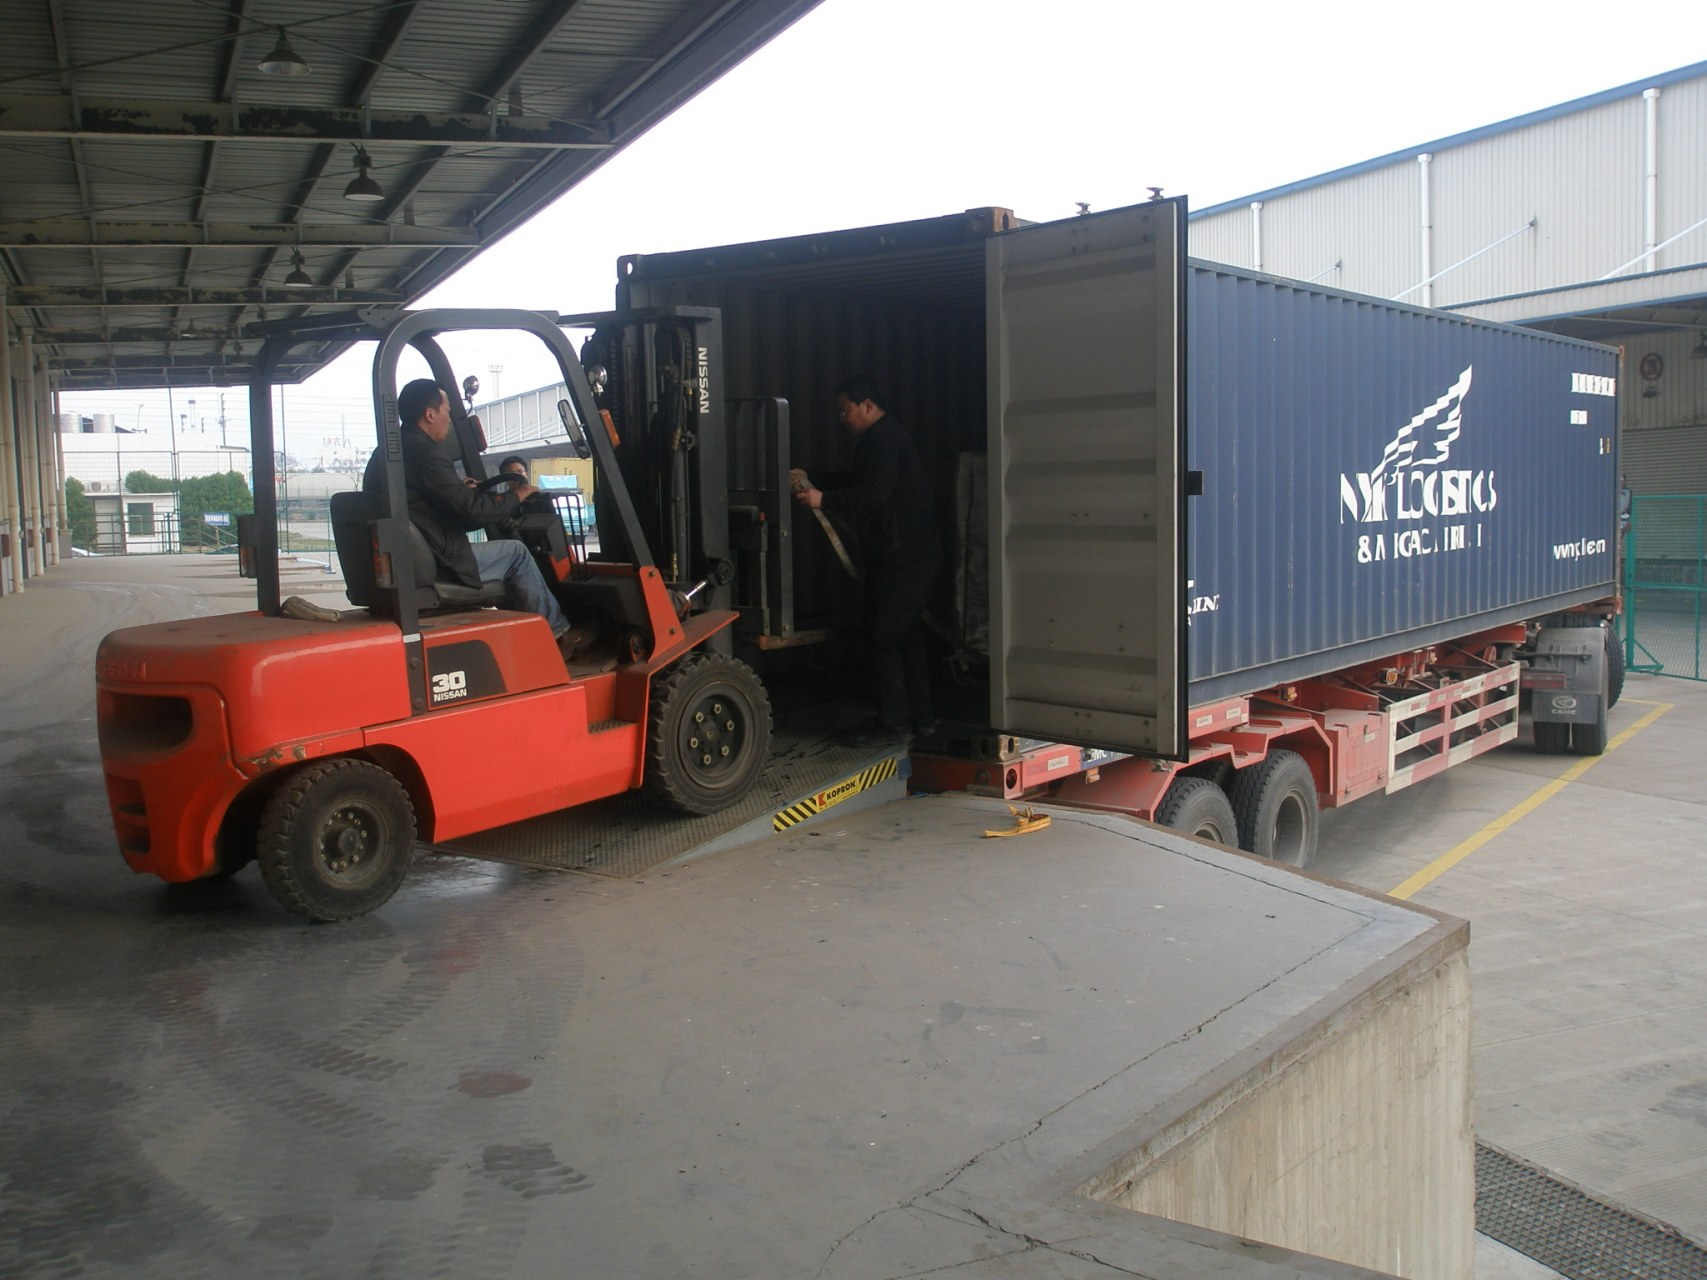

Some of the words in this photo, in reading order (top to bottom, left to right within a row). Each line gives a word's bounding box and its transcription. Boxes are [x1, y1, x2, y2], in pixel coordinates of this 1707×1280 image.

[698, 346, 710, 414] NISSAN
[1357, 535, 1372, 563] &
[432, 670, 466, 693] 30
[433, 688, 467, 703] NISSAN
[826, 779, 856, 801] KOPRON
